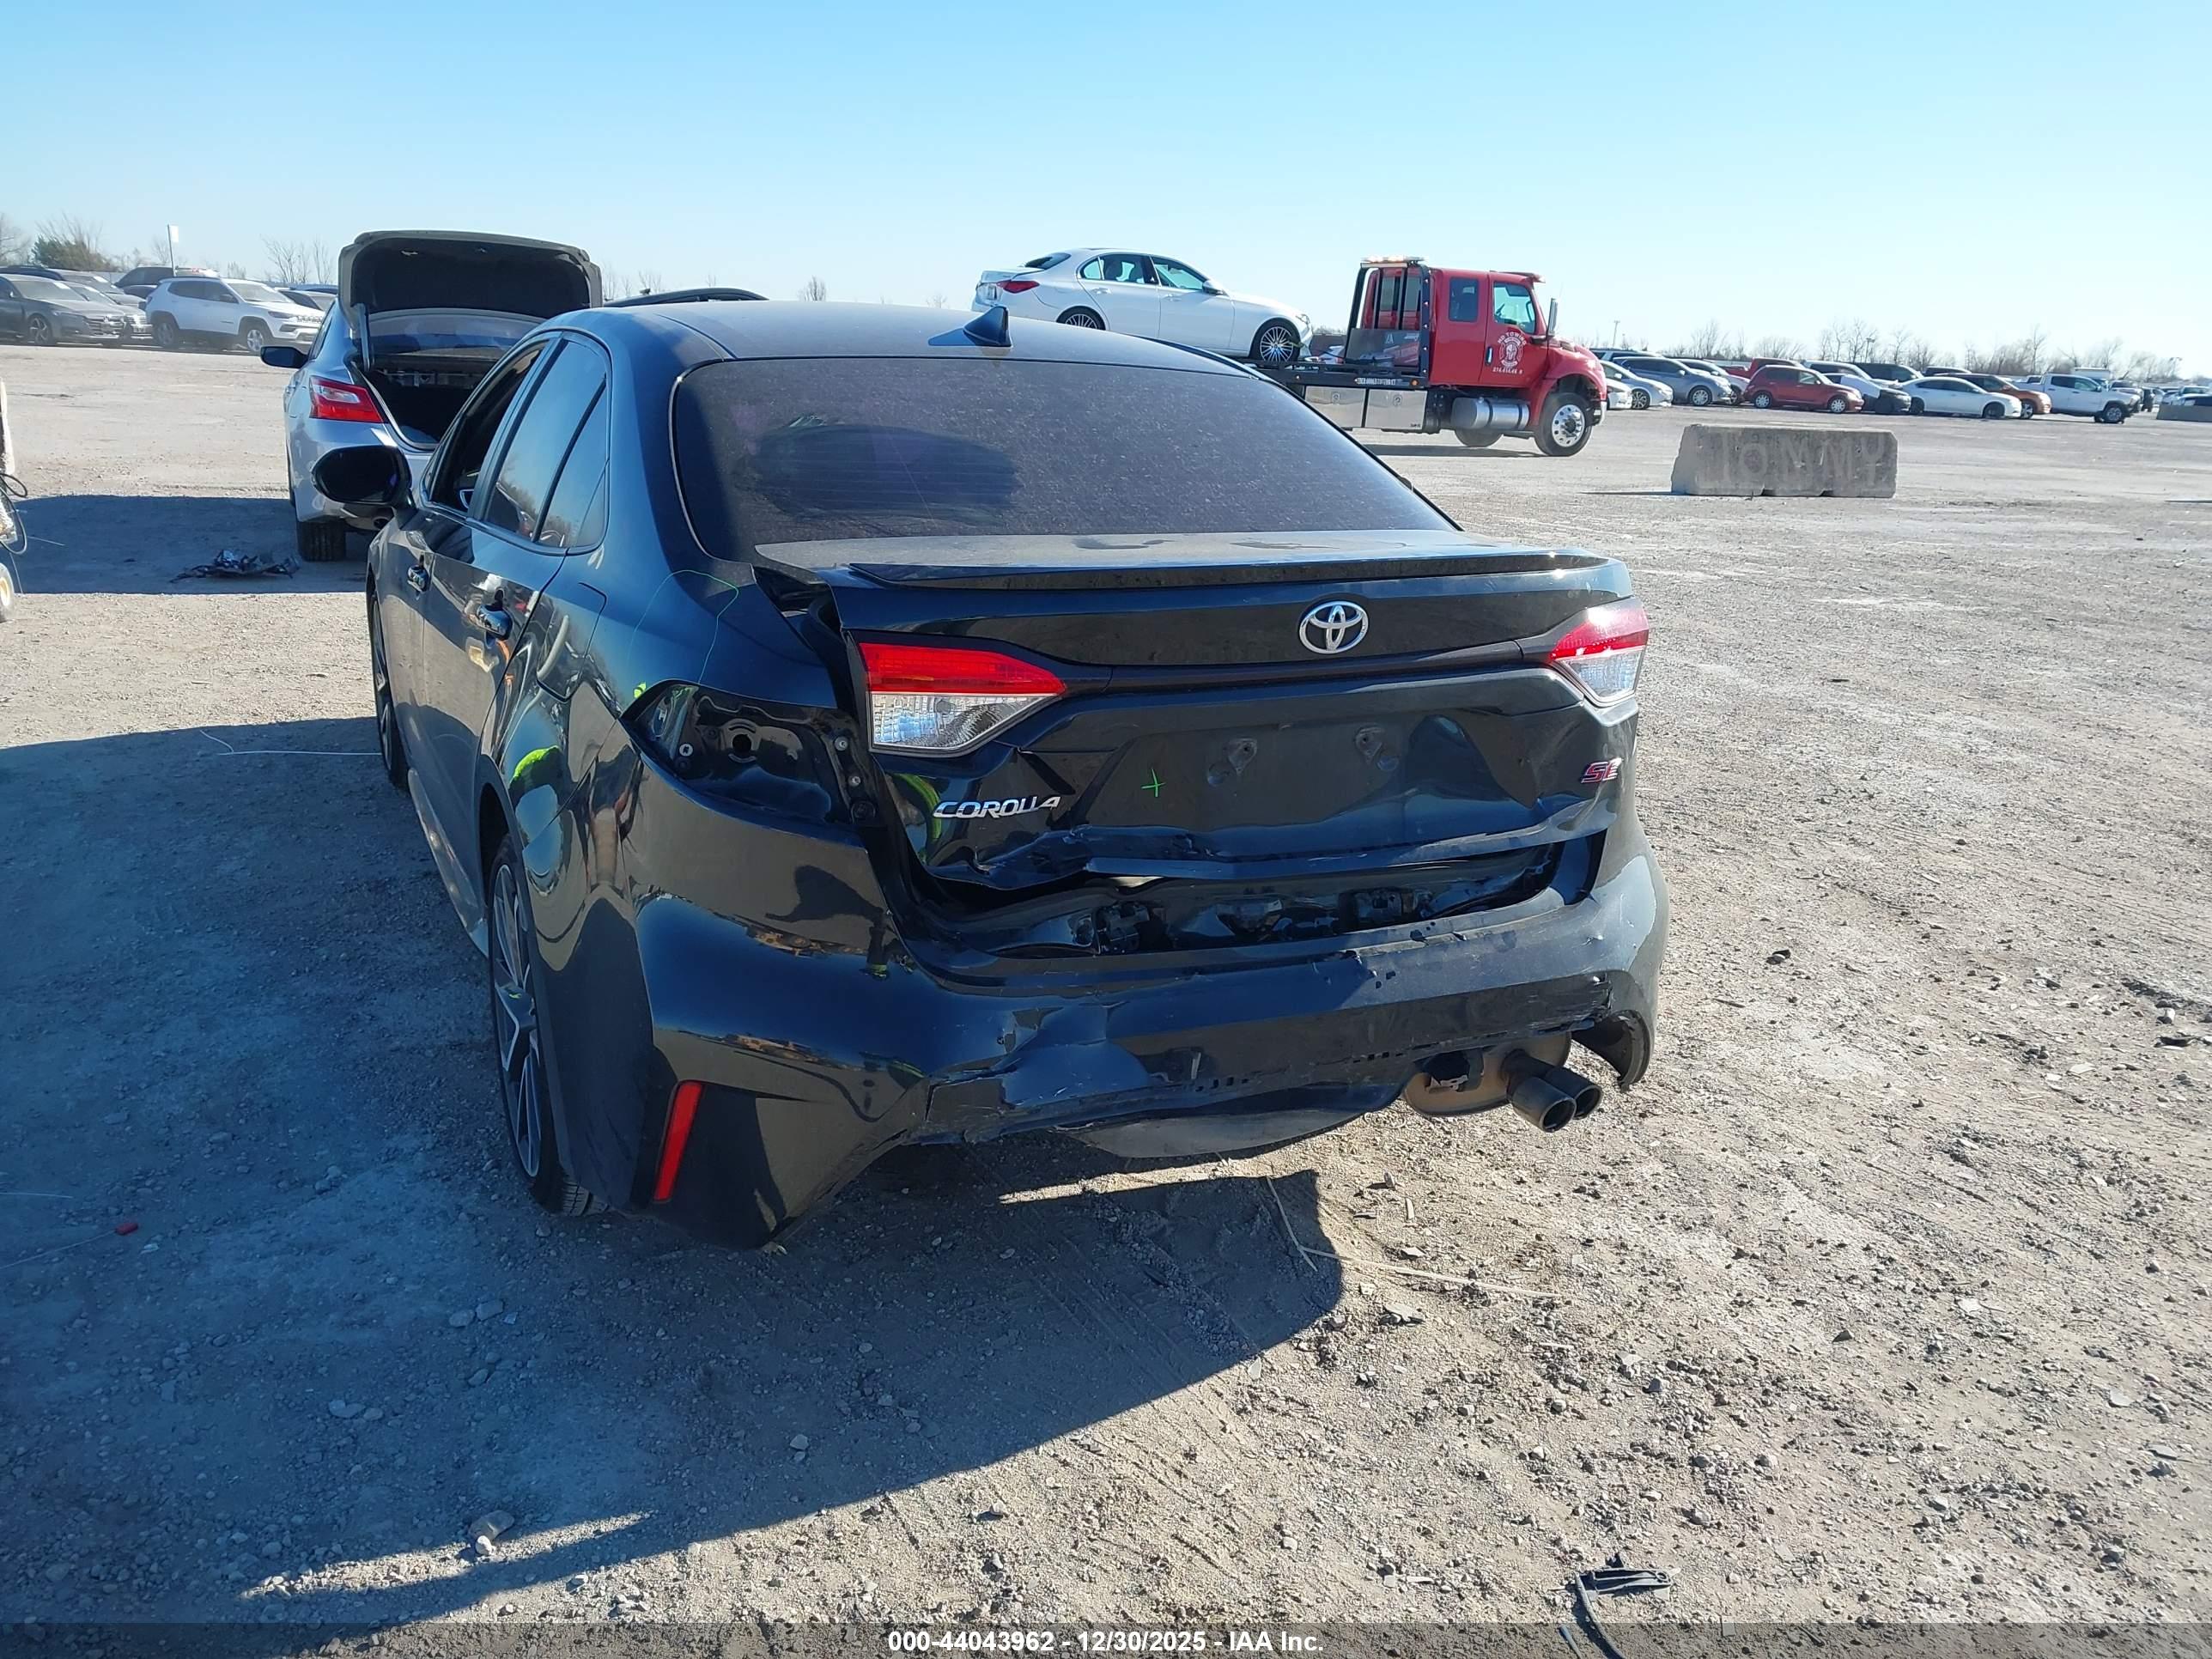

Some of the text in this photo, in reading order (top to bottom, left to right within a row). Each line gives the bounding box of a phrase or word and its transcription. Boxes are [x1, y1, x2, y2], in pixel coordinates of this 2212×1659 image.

[1505, 331, 1527, 346] TOWING
[1581, 757, 1623, 783] SE
[933, 795, 1061, 818] COROLLA
